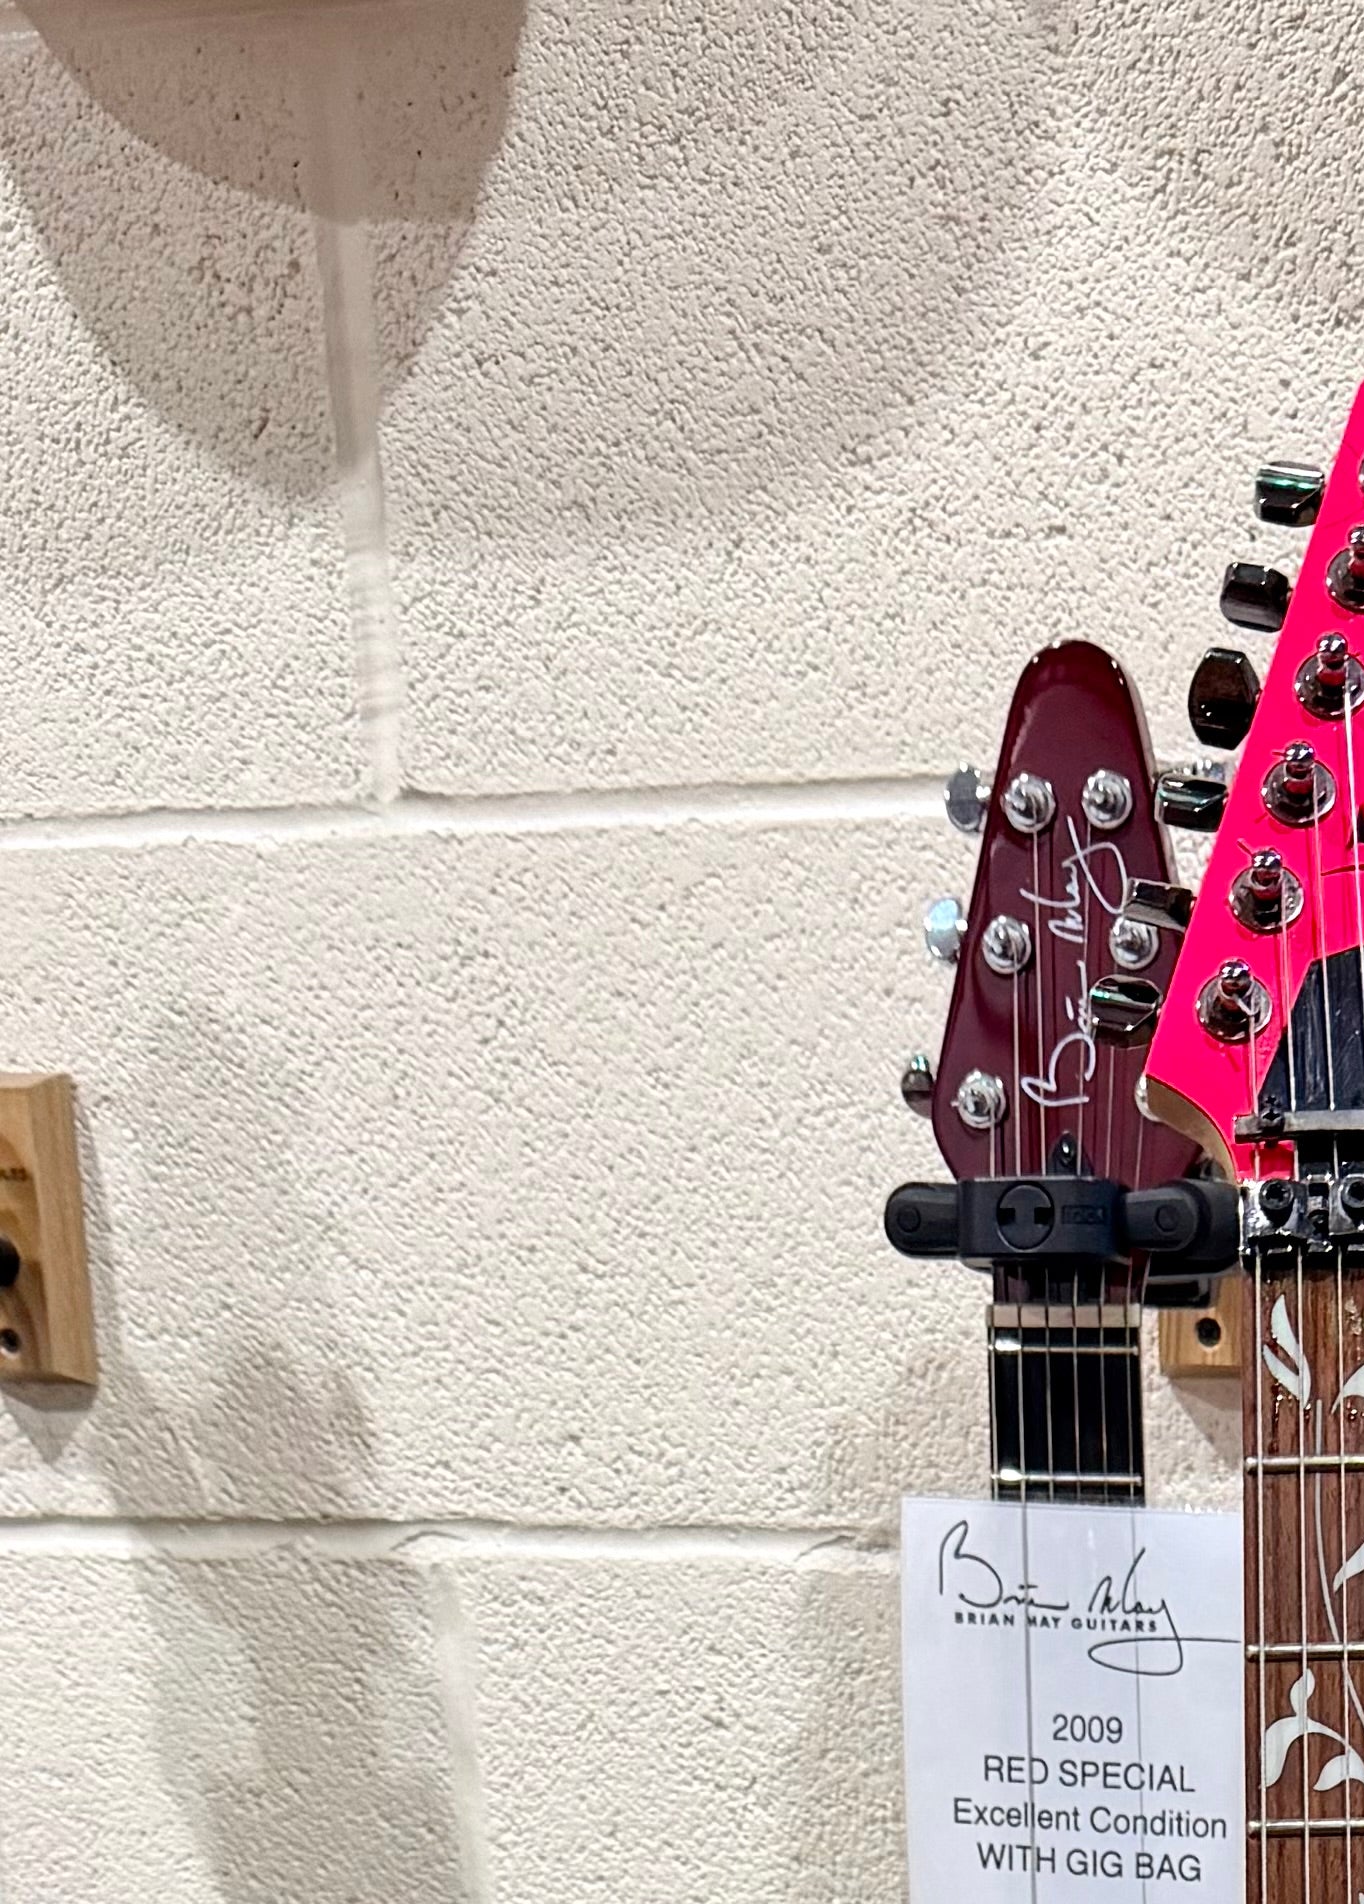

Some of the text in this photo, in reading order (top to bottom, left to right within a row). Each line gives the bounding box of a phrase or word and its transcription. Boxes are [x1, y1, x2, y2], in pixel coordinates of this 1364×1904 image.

[954, 1611, 1158, 1634] BRIAN MAY GUITARS
[1051, 1713, 1124, 1745] 2009
[983, 1754, 1196, 1793] RED SPECIAL
[952, 1796, 1228, 1839] Excellent Condition
[976, 1841, 1202, 1883] WITH GIG BAG
